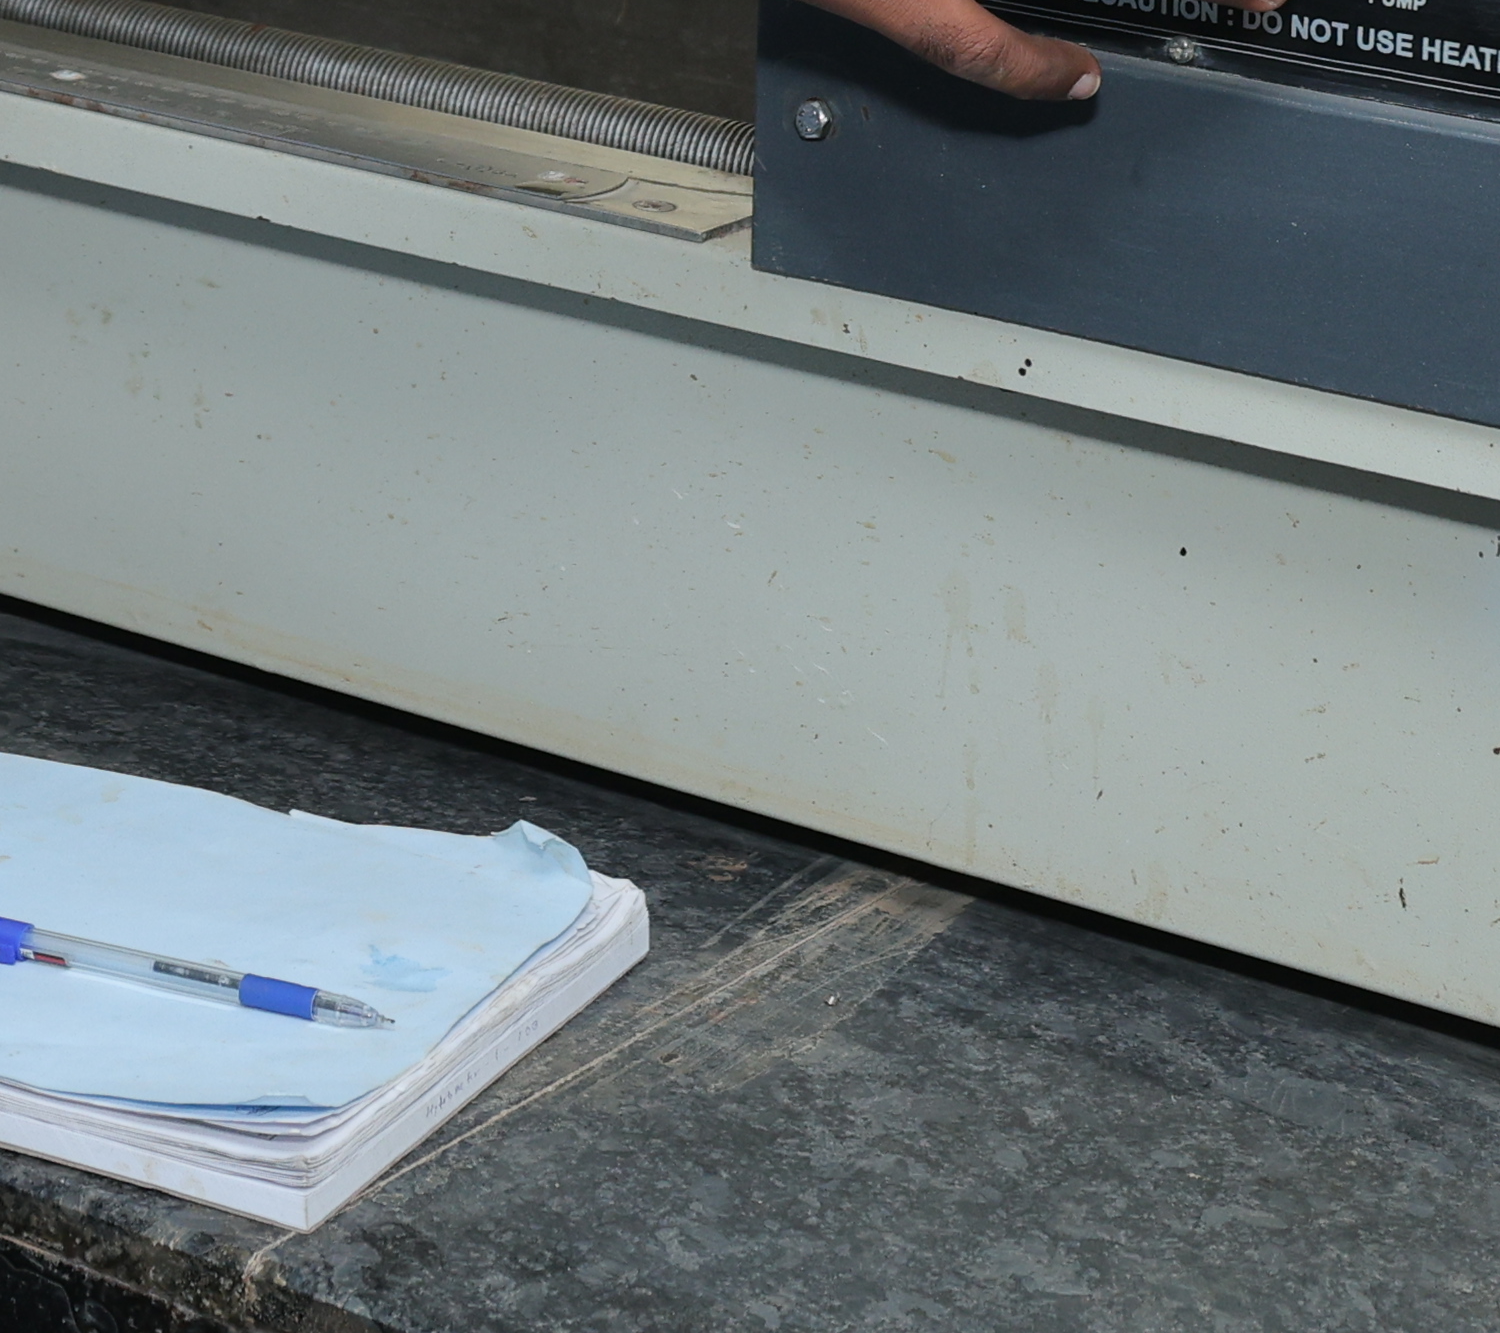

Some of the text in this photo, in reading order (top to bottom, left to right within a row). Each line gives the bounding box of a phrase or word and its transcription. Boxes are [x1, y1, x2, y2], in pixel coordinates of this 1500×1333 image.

[1242, 10, 1283, 34] DO
[1290, 14, 1349, 47] NOT
[1356, 25, 1414, 58] USE
